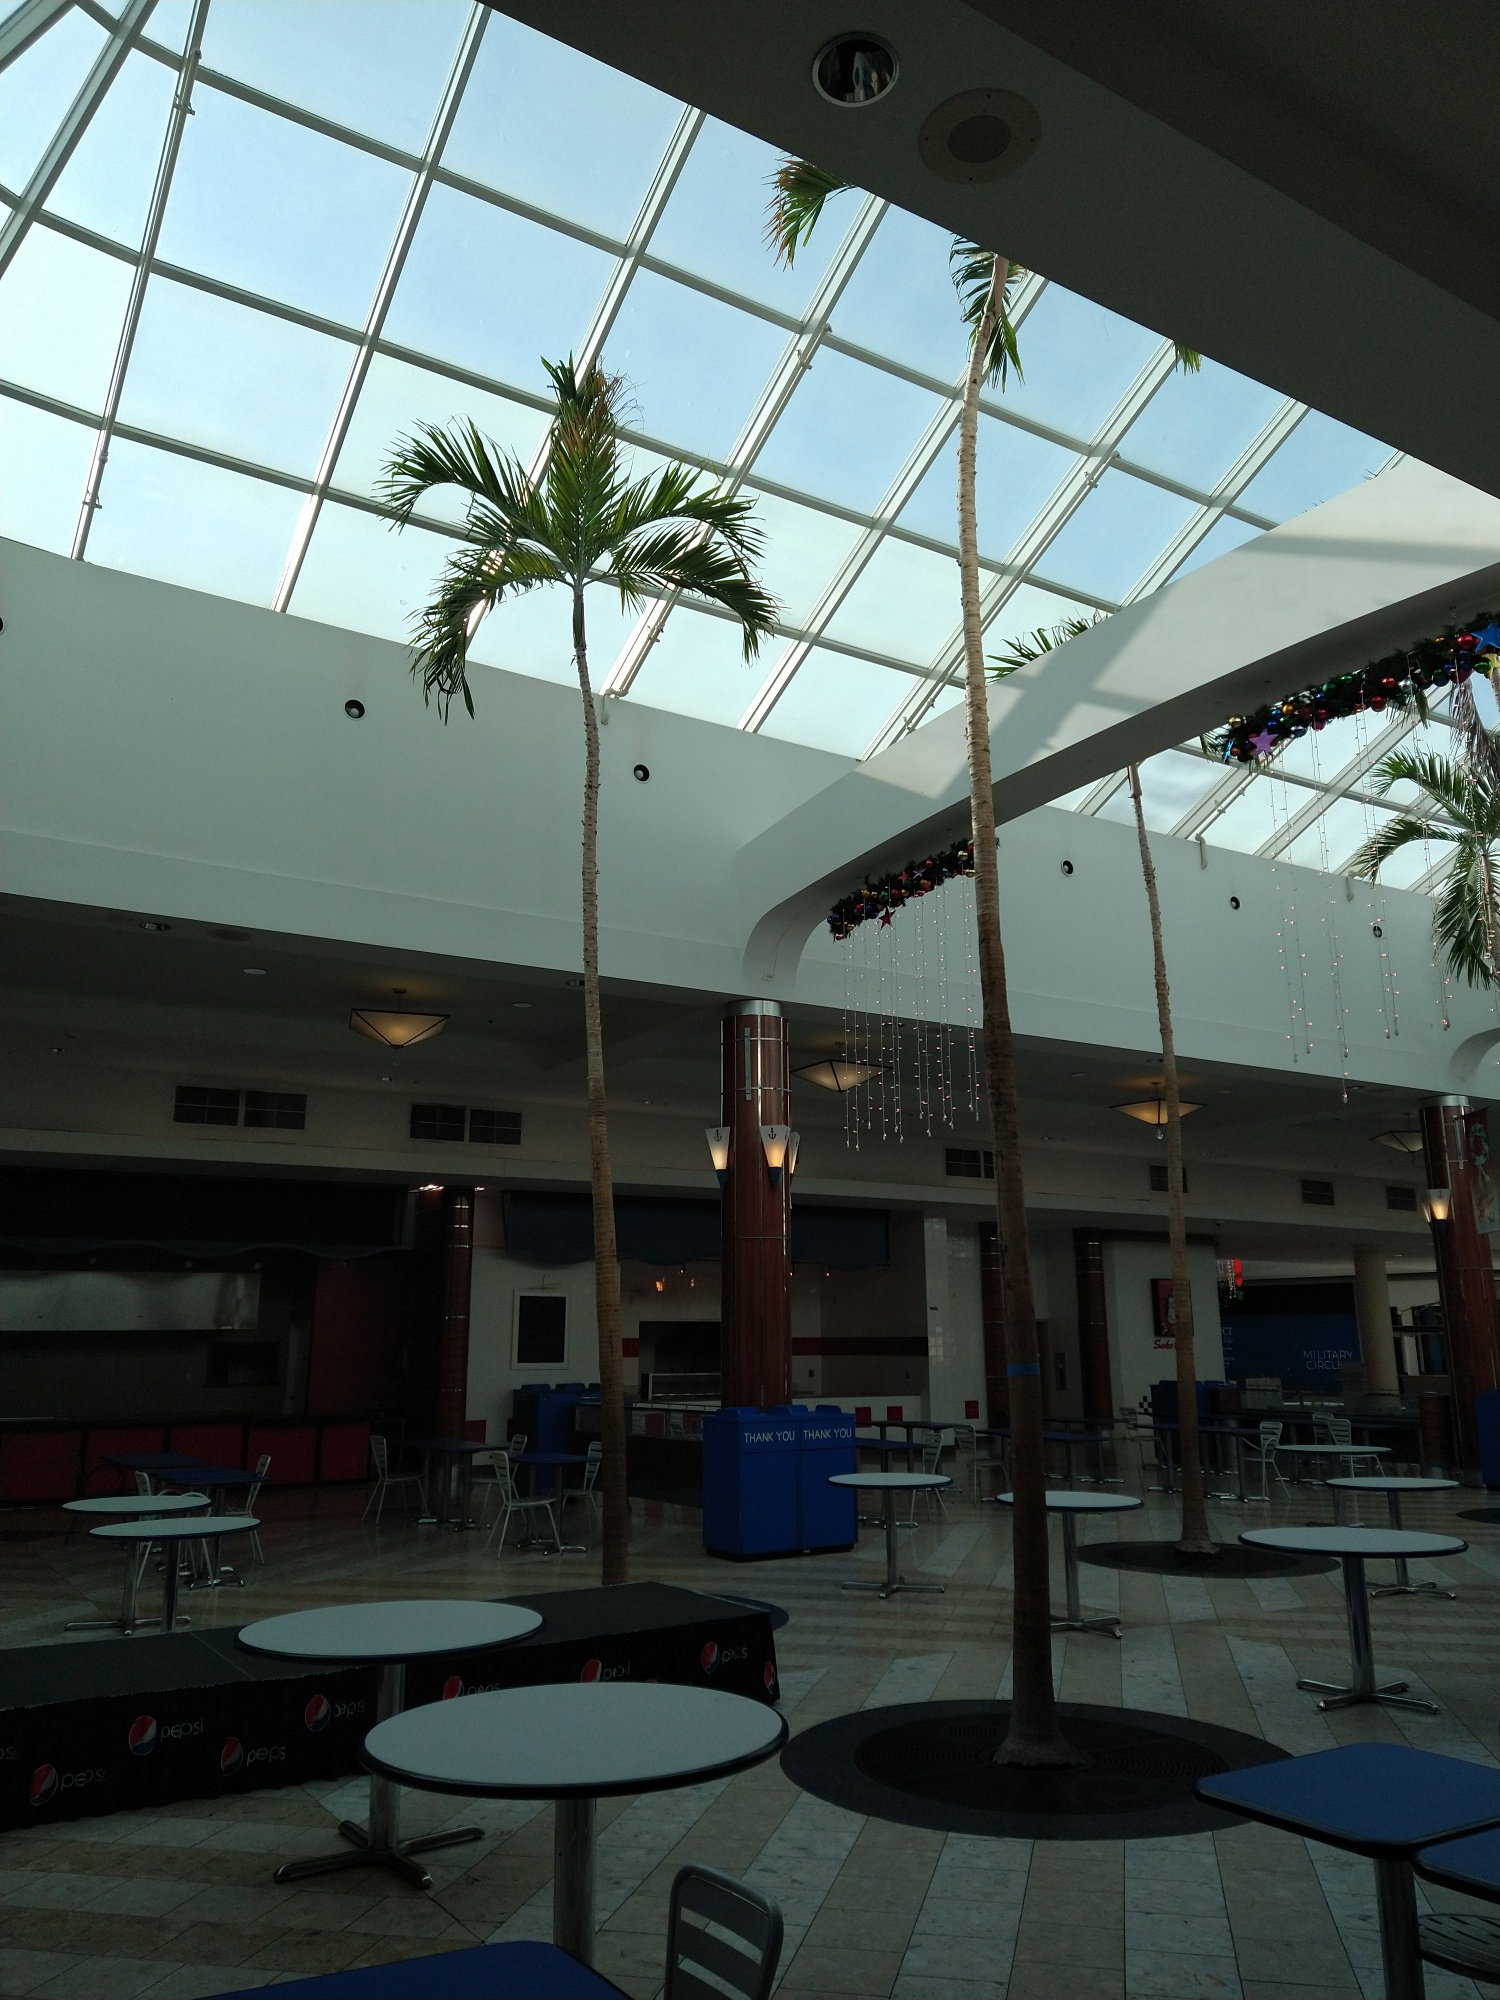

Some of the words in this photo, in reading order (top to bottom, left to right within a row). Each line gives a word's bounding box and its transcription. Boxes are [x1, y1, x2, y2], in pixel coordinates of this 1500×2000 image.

[1303, 1350, 1353, 1360] MILITARY
[1306, 1360, 1344, 1371] CIRCLE
[744, 1431, 773, 1444] THANK
[775, 1430, 796, 1442] YOU
[803, 1429, 832, 1441] THANK
[833, 1427, 853, 1439] YOU
[721, 1647, 749, 1665] peps
[160, 1717, 204, 1744] pepsi
[246, 1744, 288, 1769] peps
